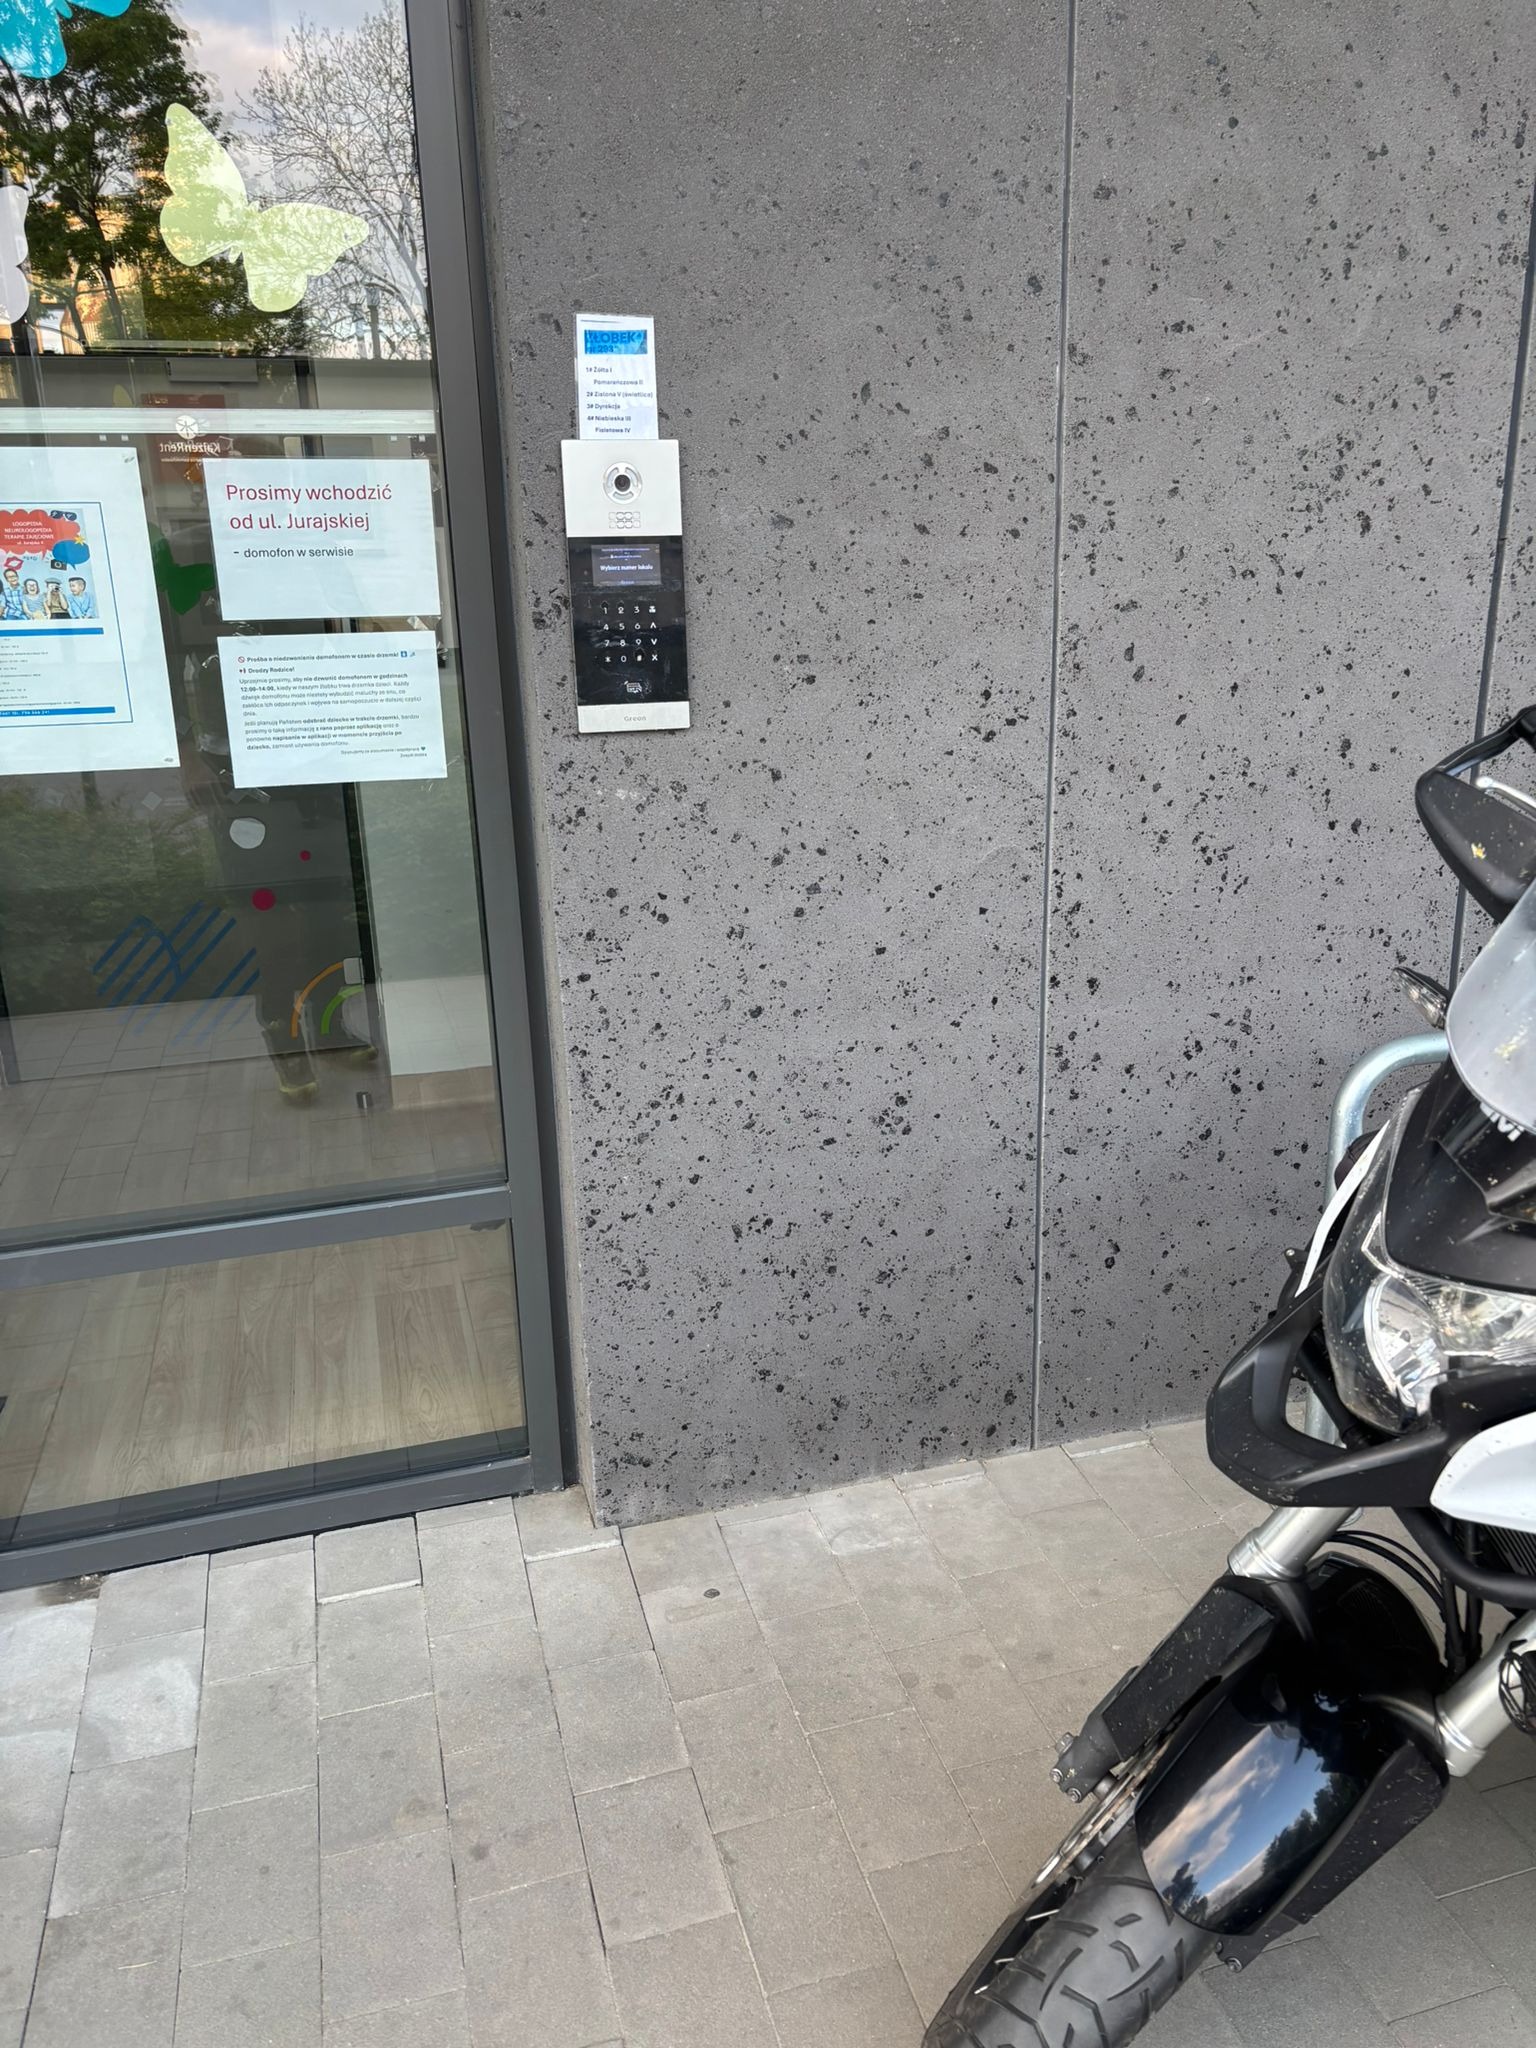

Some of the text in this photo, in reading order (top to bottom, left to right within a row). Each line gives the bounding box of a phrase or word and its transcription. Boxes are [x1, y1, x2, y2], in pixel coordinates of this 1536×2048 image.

[226, 484, 392, 504] Prosimy wchodzić
[230, 513, 370, 532] od ul. Jurajskiej
[244, 548, 294, 558] domofon
[297, 549, 306, 557] w
[309, 547, 354, 557] serwisie
[634, 606, 640, 614] 3
[620, 623, 625, 631] 5
